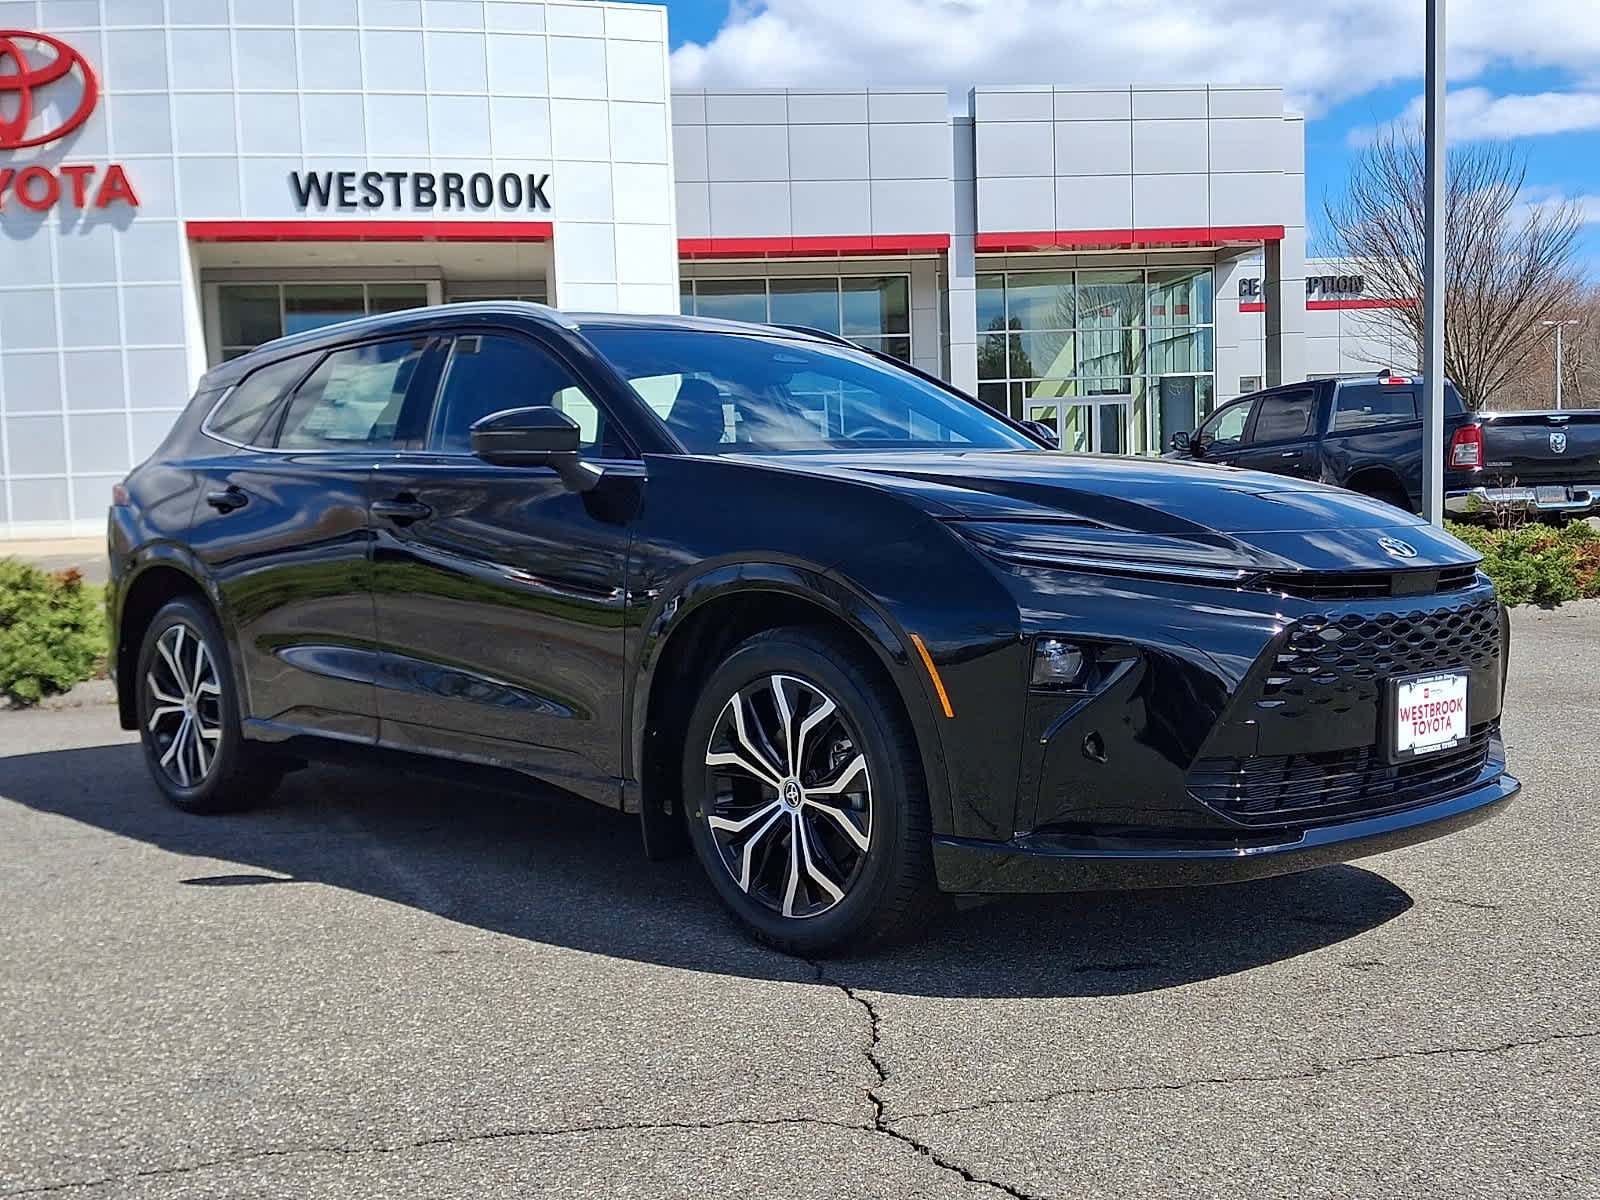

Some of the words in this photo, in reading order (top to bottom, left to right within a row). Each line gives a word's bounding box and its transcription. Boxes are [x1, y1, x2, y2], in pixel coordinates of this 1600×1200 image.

[290, 171, 551, 209] WESTBROOK
[1400, 697, 1463, 722] WESTBROOK
[1412, 716, 1452, 736] TOYOTA
